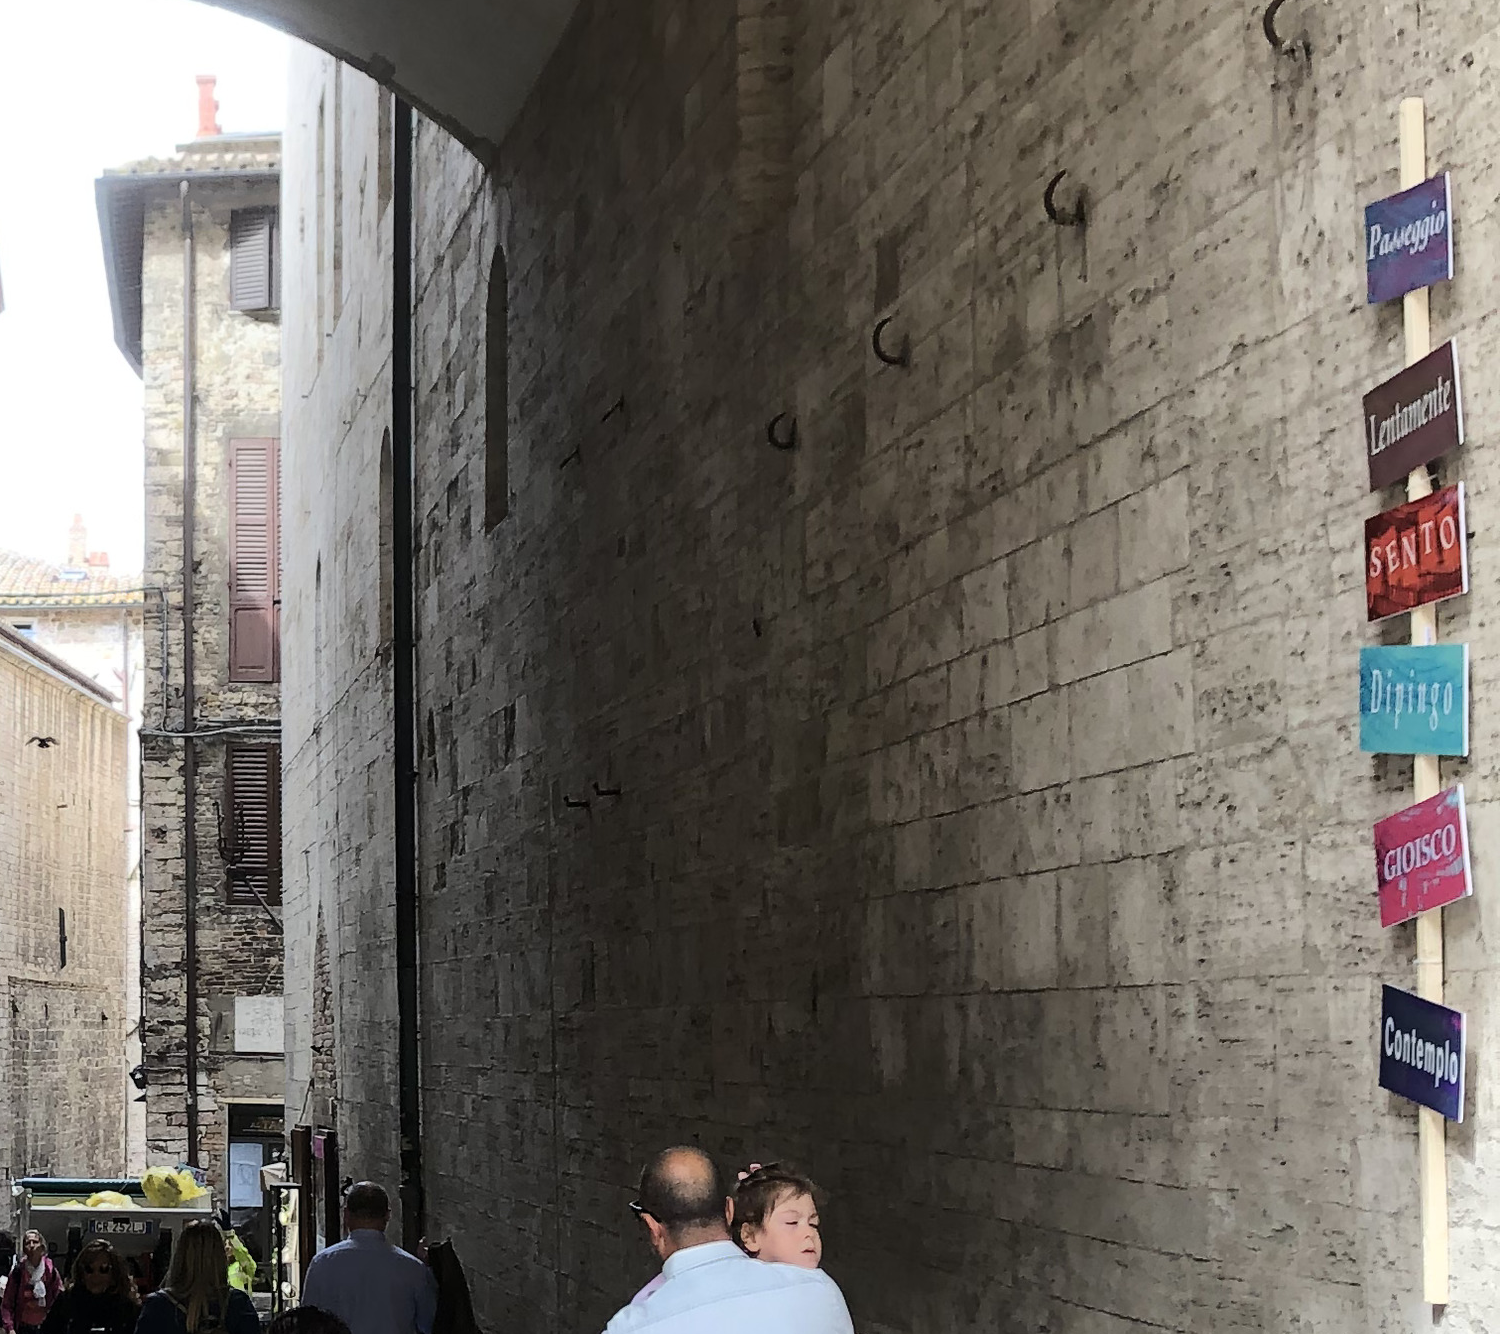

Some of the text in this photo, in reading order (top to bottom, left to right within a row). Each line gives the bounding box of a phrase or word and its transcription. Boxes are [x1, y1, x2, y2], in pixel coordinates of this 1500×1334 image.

[1368, 199, 1446, 260] Passeggio
[1369, 375, 1451, 456] Lentamente
[1369, 515, 1456, 578] SENTO
[1370, 668, 1453, 732] Dipingo
[1383, 823, 1457, 881] GIOISCO
[1384, 1016, 1458, 1088] Contemplo
